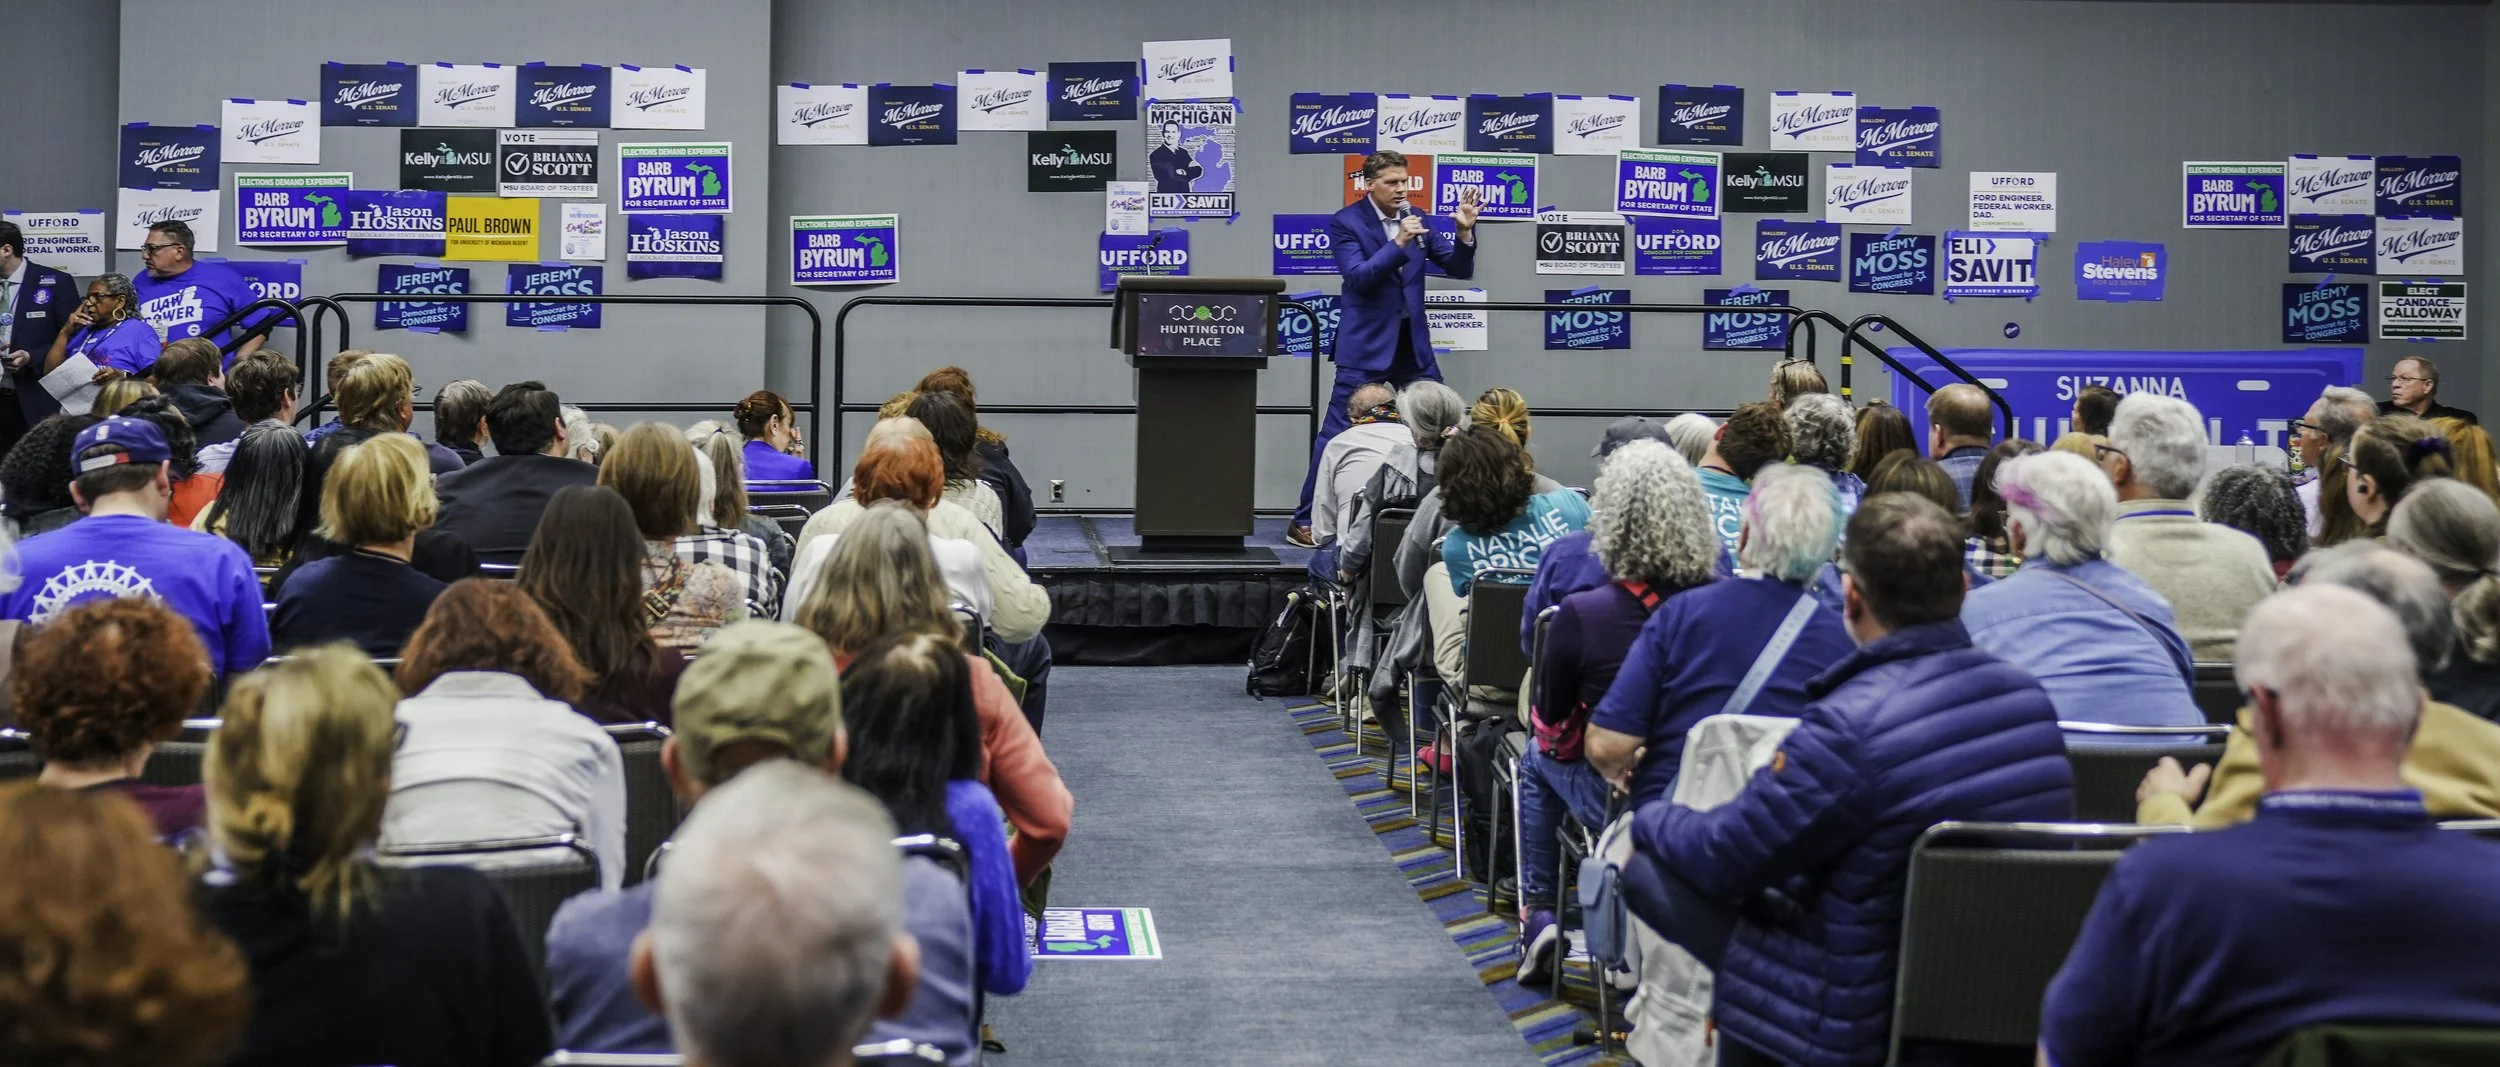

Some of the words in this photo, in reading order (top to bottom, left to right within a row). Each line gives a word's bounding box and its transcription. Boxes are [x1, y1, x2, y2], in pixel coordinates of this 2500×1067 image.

[1157, 57, 1216, 78] McMorrow
[334, 82, 402, 105] McMorrow
[434, 84, 500, 105] McMorrow
[530, 83, 597, 104] McMorrow
[626, 84, 690, 107] McMorrow
[1062, 78, 1124, 100] McMorrow
[971, 89, 1032, 110] McMorrow
[792, 102, 853, 124] McMorrow
[881, 102, 944, 124] McMorrow
[1151, 111, 1232, 125] MICHIGAN
[1671, 103, 1731, 128] McMorrow
[236, 118, 304, 141] McMorrow
[1291, 108, 1375, 143] McMorrow
[1379, 109, 1462, 143] McMorrow
[1479, 112, 1540, 139] McMorrow
[1567, 113, 1626, 138] McMorrow
[1772, 106, 1853, 140] McMorrow
[504, 134, 535, 142] VOTE
[1857, 120, 1939, 156] McMorrow
[134, 143, 205, 166] McMorrow
[405, 152, 439, 167] Kelly
[457, 153, 488, 165] MSU
[533, 153, 592, 162] BRIANNA
[1032, 153, 1063, 168] Kelly
[1080, 154, 1109, 165] MSU
[533, 163, 592, 176] SCOTT
[638, 161, 671, 176] BARB
[1452, 169, 1484, 183] BARB
[1634, 166, 1666, 180] BARB
[629, 176, 696, 198] BYRUM
[1727, 174, 1757, 189] Kelly
[1774, 175, 1800, 186] MSU
[1992, 177, 2034, 185] UFFORD
[2202, 179, 2234, 192] BARB
[2290, 168, 2373, 204] McMorrow
[2376, 168, 2459, 205] McMorrow
[255, 192, 289, 206] BARB
[1624, 180, 1688, 202] BYRUM
[1828, 178, 1909, 212] McMorrow
[1974, 194, 1997, 202] FORD
[643, 199, 688, 207] SECRETARY
[702, 198, 726, 206] STATE
[1152, 196, 1172, 208] ELI
[1187, 196, 1229, 209] SAVIT
[1637, 202, 1679, 211] SECRETARY
[1691, 205, 1713, 213] STATE
[2193, 194, 2255, 213] BYRUM
[246, 207, 315, 230] BYRUM
[350, 211, 442, 230] HOSKINS
[386, 206, 432, 218] Jason
[29, 218, 79, 228] UFFORD
[449, 218, 481, 233] PAUL
[484, 218, 531, 234] BROWN
[664, 228, 709, 240] Jason
[808, 234, 841, 248] BARB
[1565, 232, 1619, 241] BRIANNA
[1637, 234, 1720, 250] UFFORD
[630, 234, 719, 253] HOSKINS
[1565, 242, 1619, 253] SCOTT
[1757, 233, 1840, 269] McMorrow
[1866, 237, 1916, 256] JEREMY
[1951, 239, 1981, 254] ELI
[2289, 226, 2373, 262] McMorrow
[2377, 228, 2461, 264] McMorrow
[800, 248, 865, 269] BYRUM
[1856, 249, 1928, 276] MOSS
[2102, 255, 2139, 269] Haley
[396, 270, 454, 289] JEREMY
[525, 268, 582, 289] JEREMY
[813, 270, 856, 278] SECRETARY
[1951, 259, 2032, 282] SAVIT
[2082, 262, 2157, 280] Stevens
[1872, 278, 1913, 289] CONGRESS
[2407, 287, 2440, 295] ELECT
[2302, 286, 2350, 312] JEREMY
[2396, 298, 2450, 307] CANDACE
[401, 316, 447, 327] CONGRESS
[531, 313, 577, 326] CONGRESS
[2289, 298, 2360, 327] MOSS
[2384, 307, 2462, 318] CALLOWAY
[1161, 325, 1244, 334] HUNTINGTON
[2305, 327, 2347, 340] CONGRESS
[1183, 338, 1221, 346] PLACE
[1568, 335, 1609, 347] CONGRESS
[1726, 334, 1768, 347] CONGRESS
[1466, 508, 1568, 558] NATALIE
